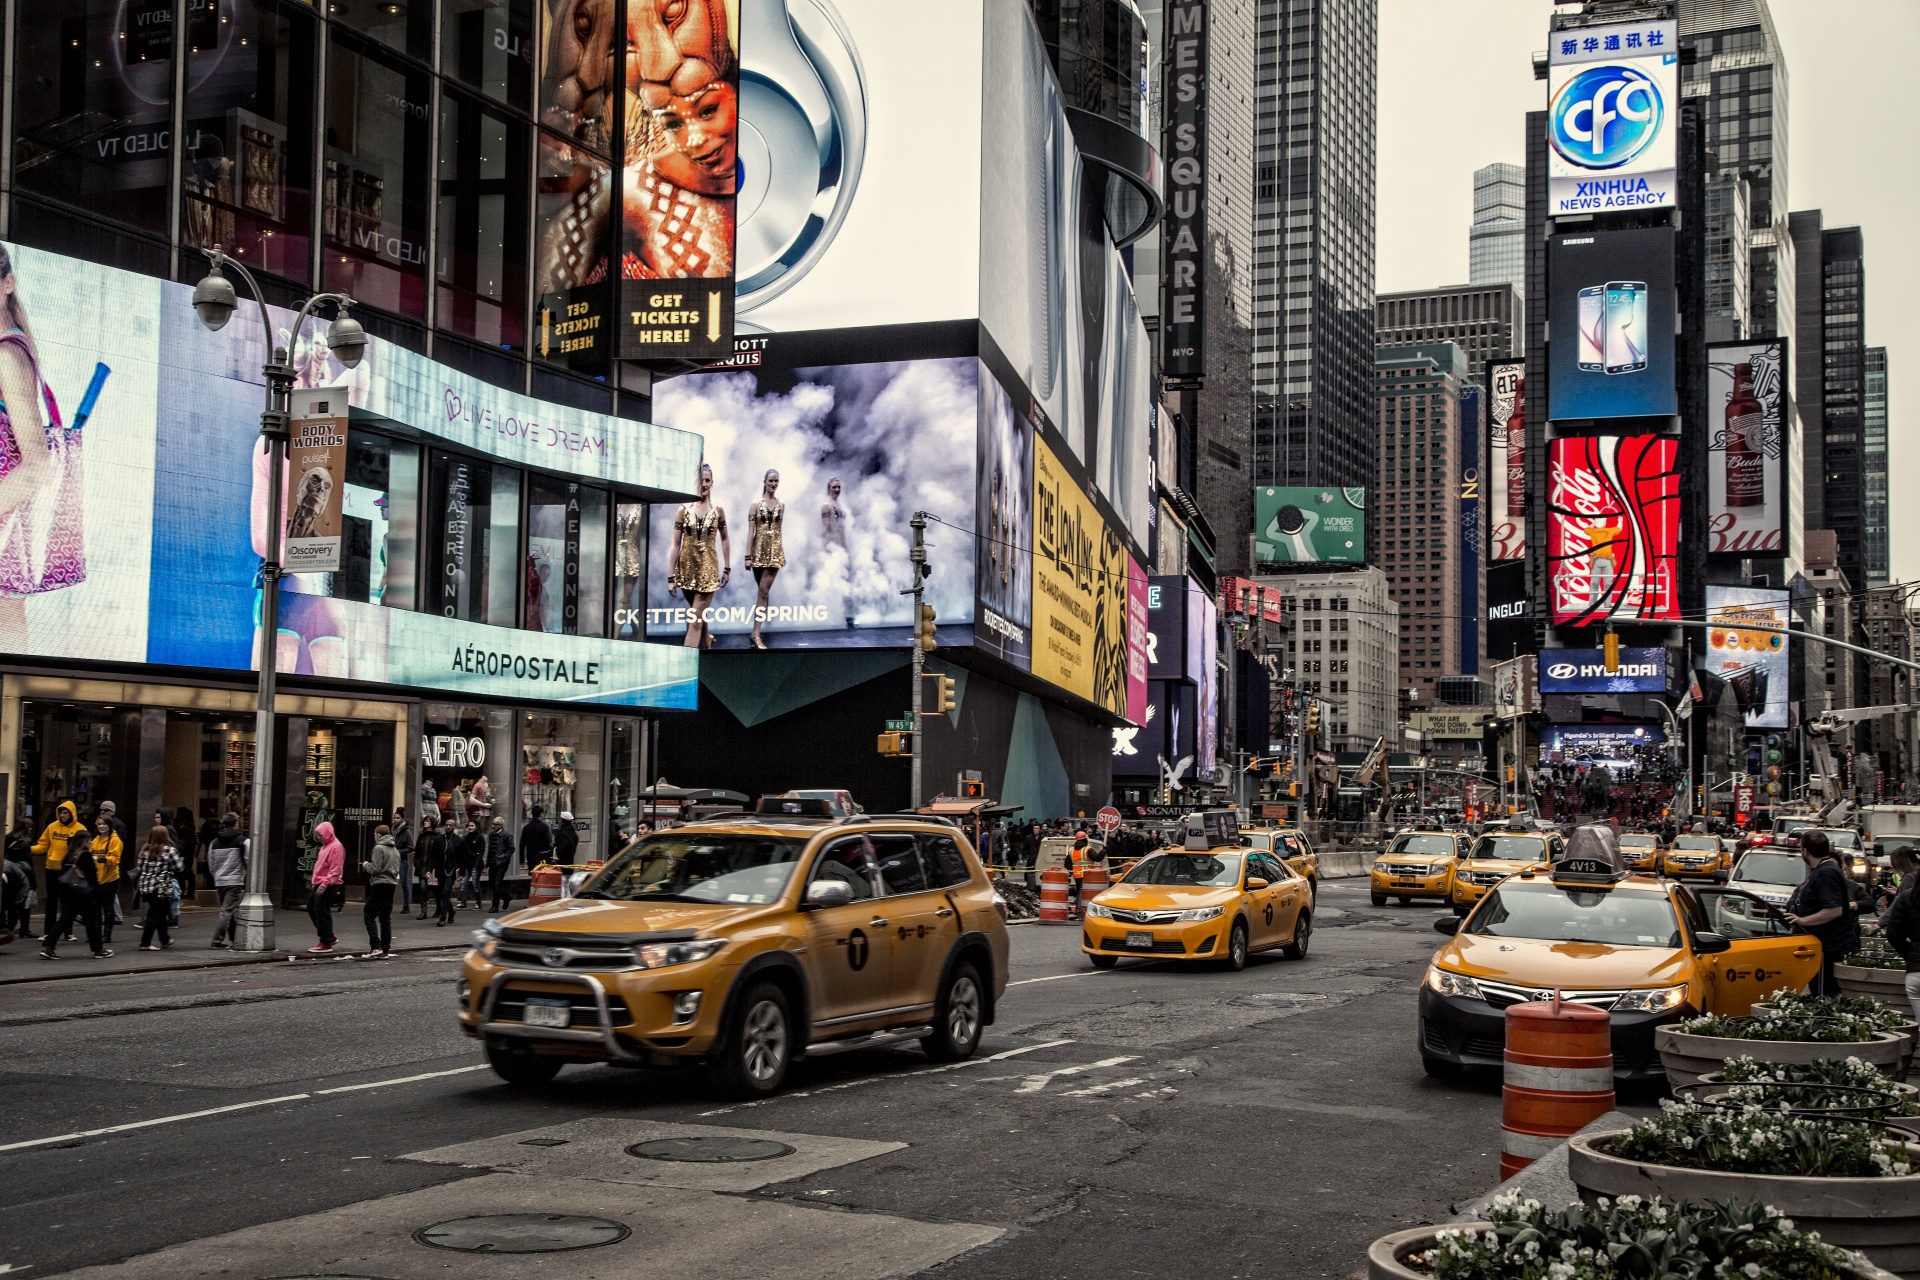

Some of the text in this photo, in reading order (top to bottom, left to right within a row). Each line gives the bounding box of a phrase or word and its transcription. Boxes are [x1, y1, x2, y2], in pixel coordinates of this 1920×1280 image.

[1561, 30, 1664, 55] 新华通讯社
[1576, 178, 1649, 197] XINHUA
[1560, 192, 1666, 210] NEWS AGENCY
[1171, 122, 1201, 325] SQUARE
[1562, 237, 1595, 246] SAMSUNG
[650, 294, 683, 308] GET
[631, 311, 700, 325] TICKETS
[640, 329, 690, 344] HERE!
[1172, 347, 1194, 357] NYC
[463, 404, 492, 430] LIVE
[498, 414, 539, 443] LOVE
[300, 425, 336, 437] BODY
[292, 435, 344, 448] WORLDS
[1323, 517, 1353, 525] WONDER
[1039, 480, 1093, 589] THE LION KING
[292, 546, 333, 556] Discovery
[1489, 600, 1526, 620] INGLO
[1723, 608, 1773, 621] Get Personal
[452, 643, 599, 685] AÉROPOSTALE
[896, 721, 904, 729] 45
[1564, 732, 1592, 740] Hyundai's
[421, 734, 486, 768] AERO
[1739, 788, 1753, 812] tkts
[1098, 813, 1119, 824] STOP
[1147, 806, 1197, 817] SIGNATURE
[1569, 861, 1597, 873] 4V13
